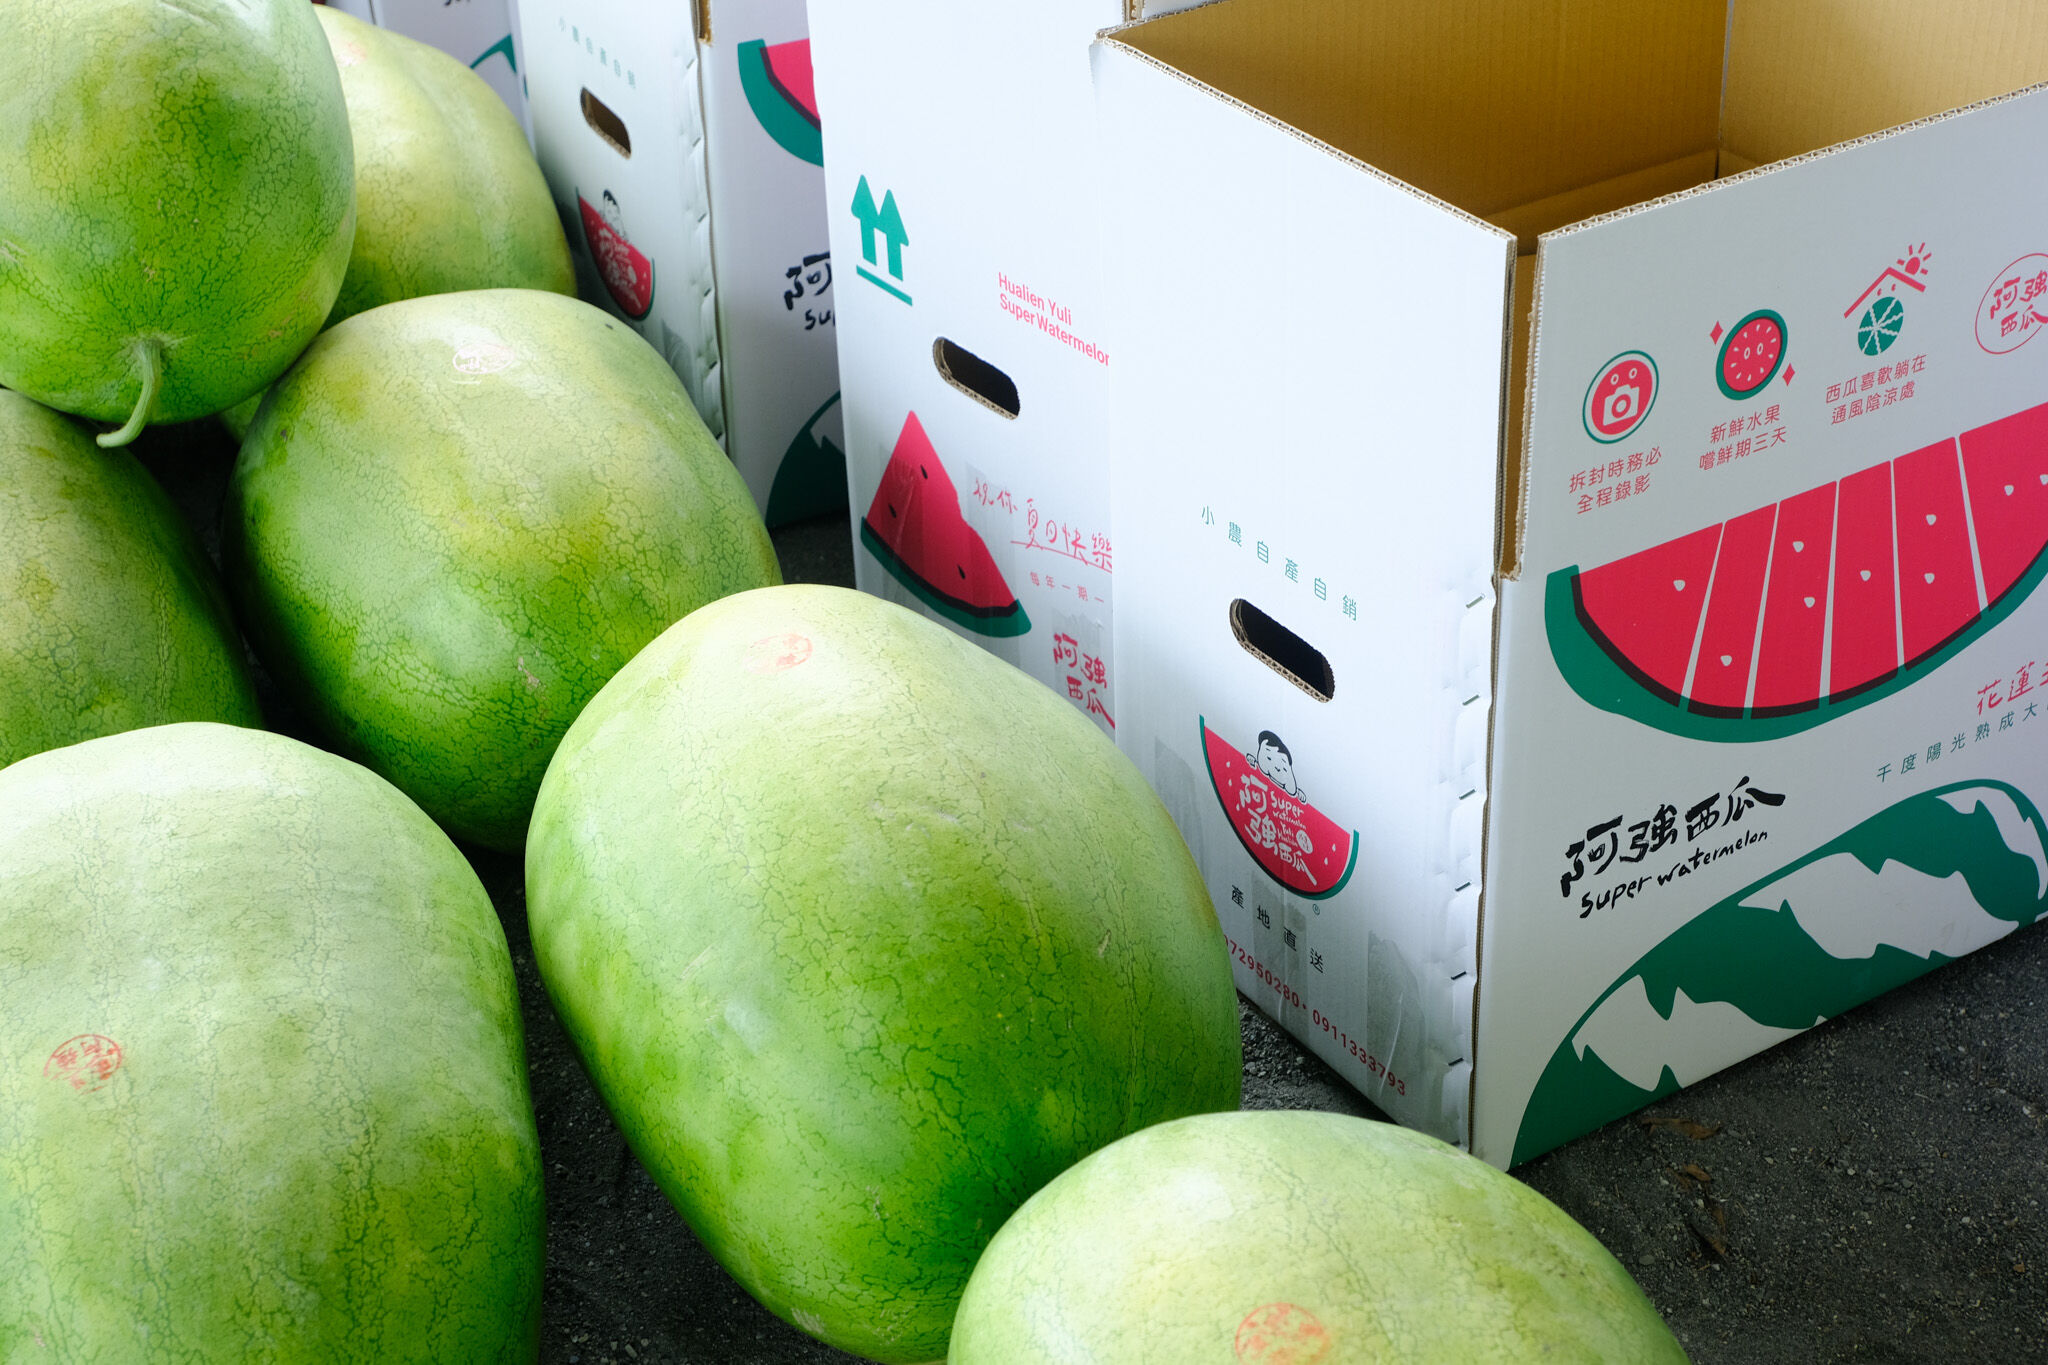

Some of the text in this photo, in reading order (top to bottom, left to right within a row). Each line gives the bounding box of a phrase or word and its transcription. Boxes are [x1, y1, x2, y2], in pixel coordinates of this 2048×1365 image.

[804, 309, 836, 330] Su
[998, 272, 1072, 325] Hualien Yuli
[1000, 293, 1035, 324] Super
[1826, 354, 1928, 404] 西瓜喜歡躺在
[1710, 404, 1780, 443] 新鮮水果
[1831, 381, 1915, 425] 通風陰涼處
[1569, 446, 1661, 494] 拆封時務必
[1699, 426, 1786, 470] 嚐鮮期三天
[1577, 472, 1650, 514] 全程錄影
[1876, 702, 2048, 783] 千度陽光熟成大
[1560, 775, 1786, 897] 阿強西瓜
[1313, 1009, 1405, 1095] 0911333793
